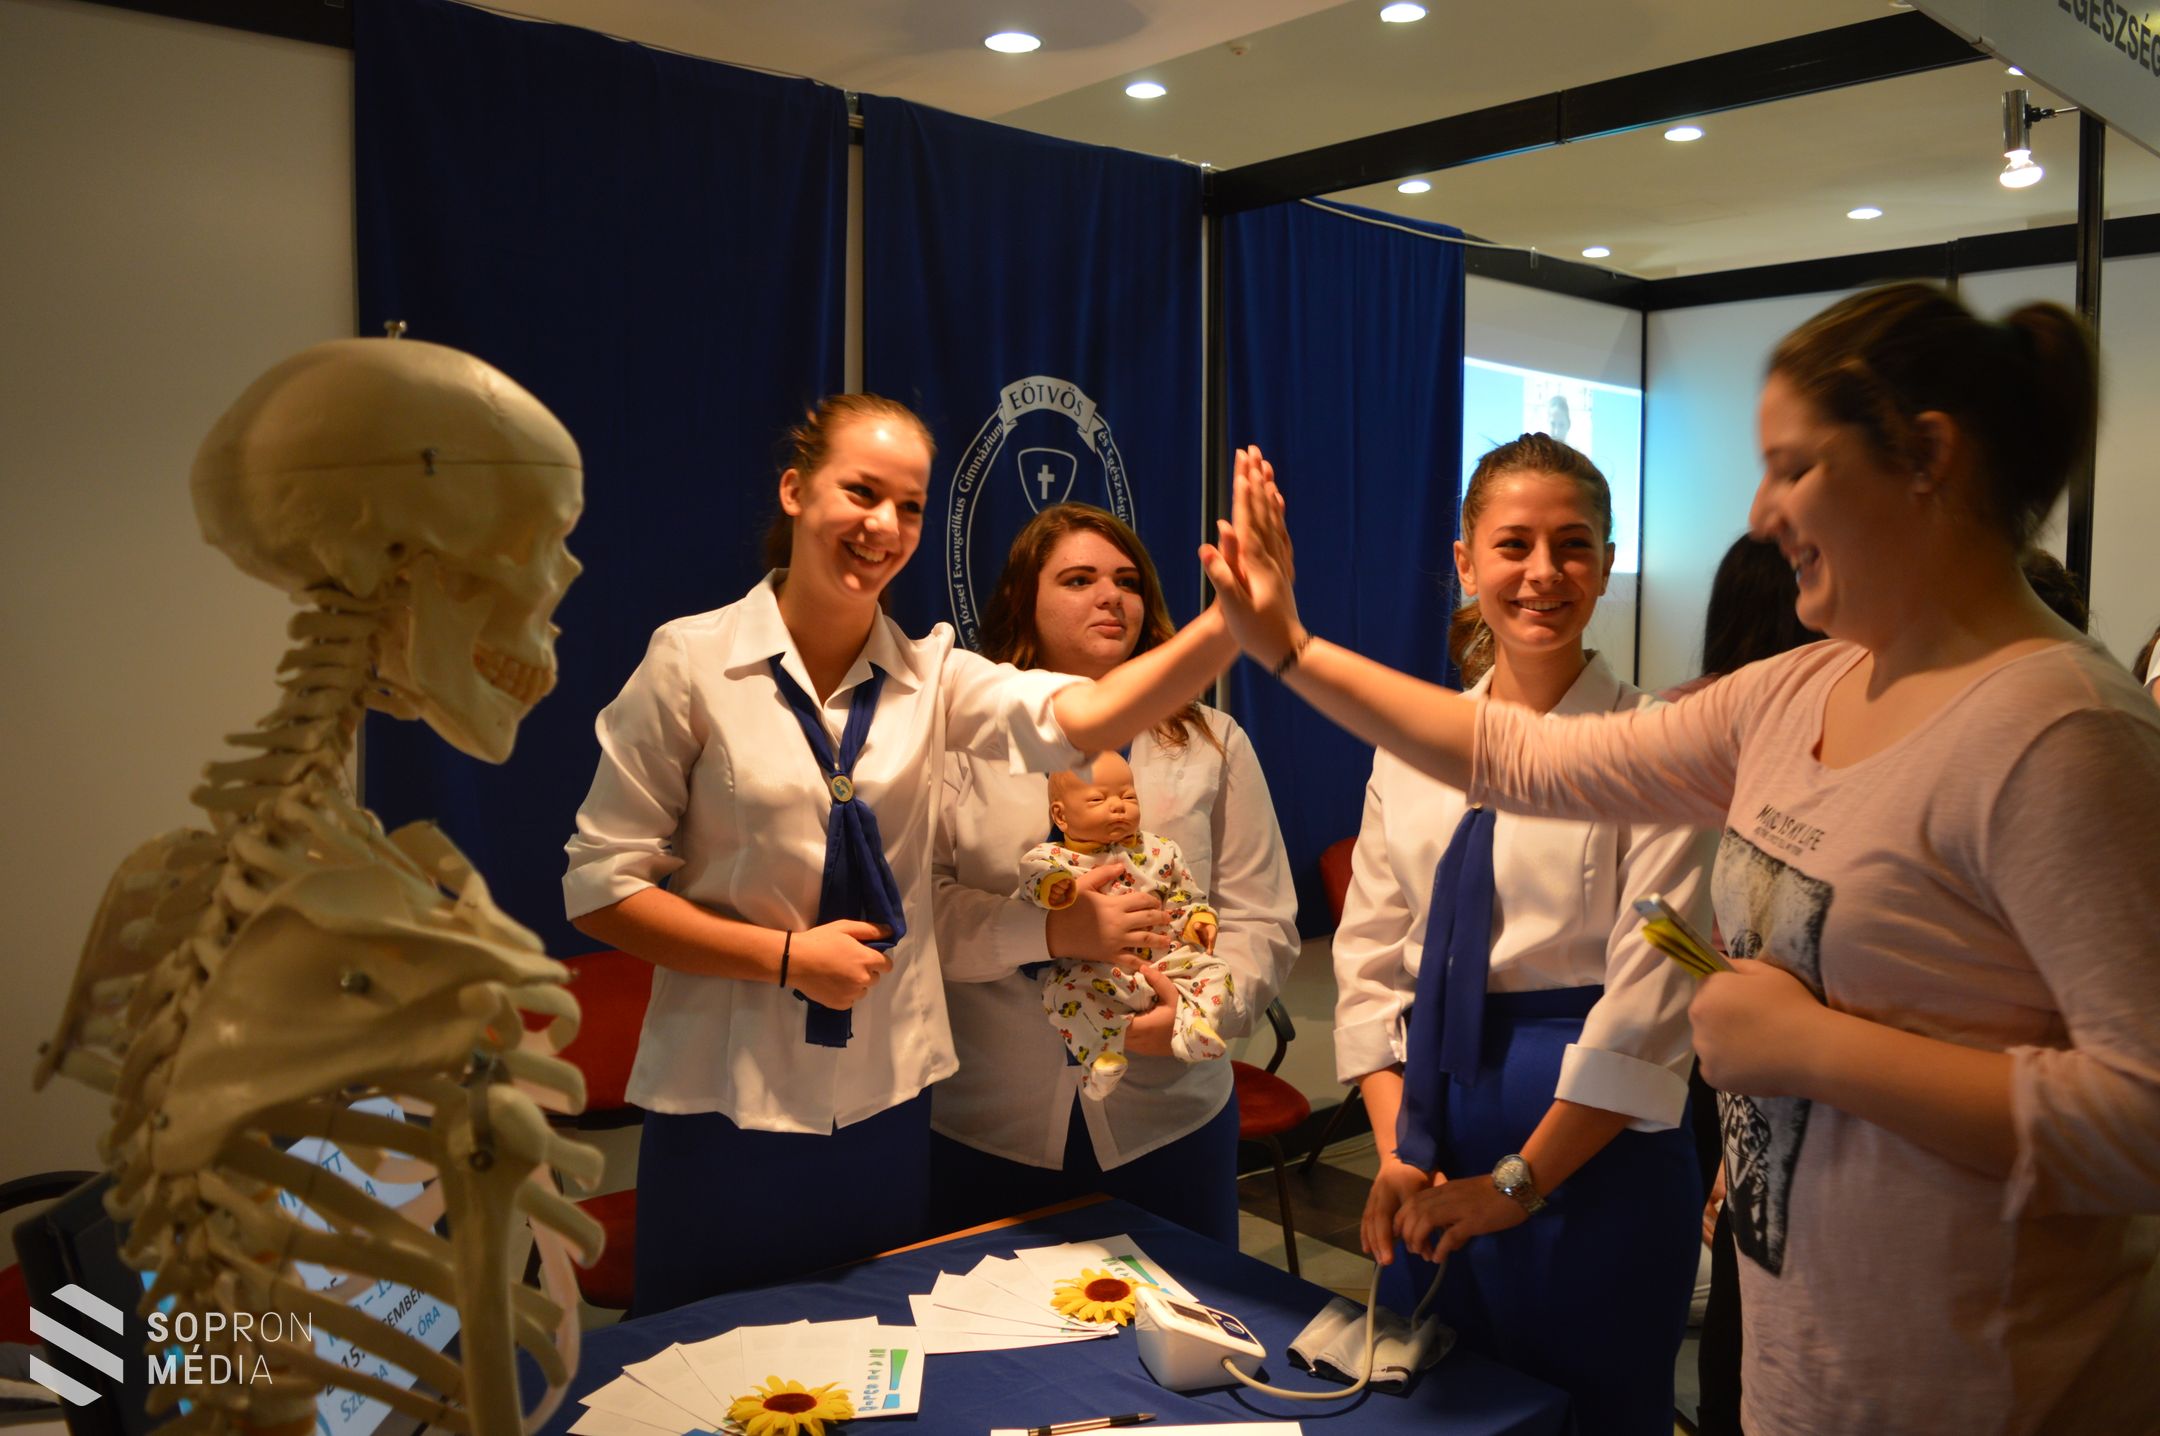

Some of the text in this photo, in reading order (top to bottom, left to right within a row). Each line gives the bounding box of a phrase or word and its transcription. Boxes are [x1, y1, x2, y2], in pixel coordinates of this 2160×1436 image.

[2058, 0, 2160, 77] GESZSÉG
[1009, 382, 1084, 417] EÖTVÖS
[957, 423, 1003, 494] Gimnázium
[952, 496, 965, 579] Evangélikus
[953, 583, 973, 626] József
[418, 1305, 441, 1337] ÓRA
